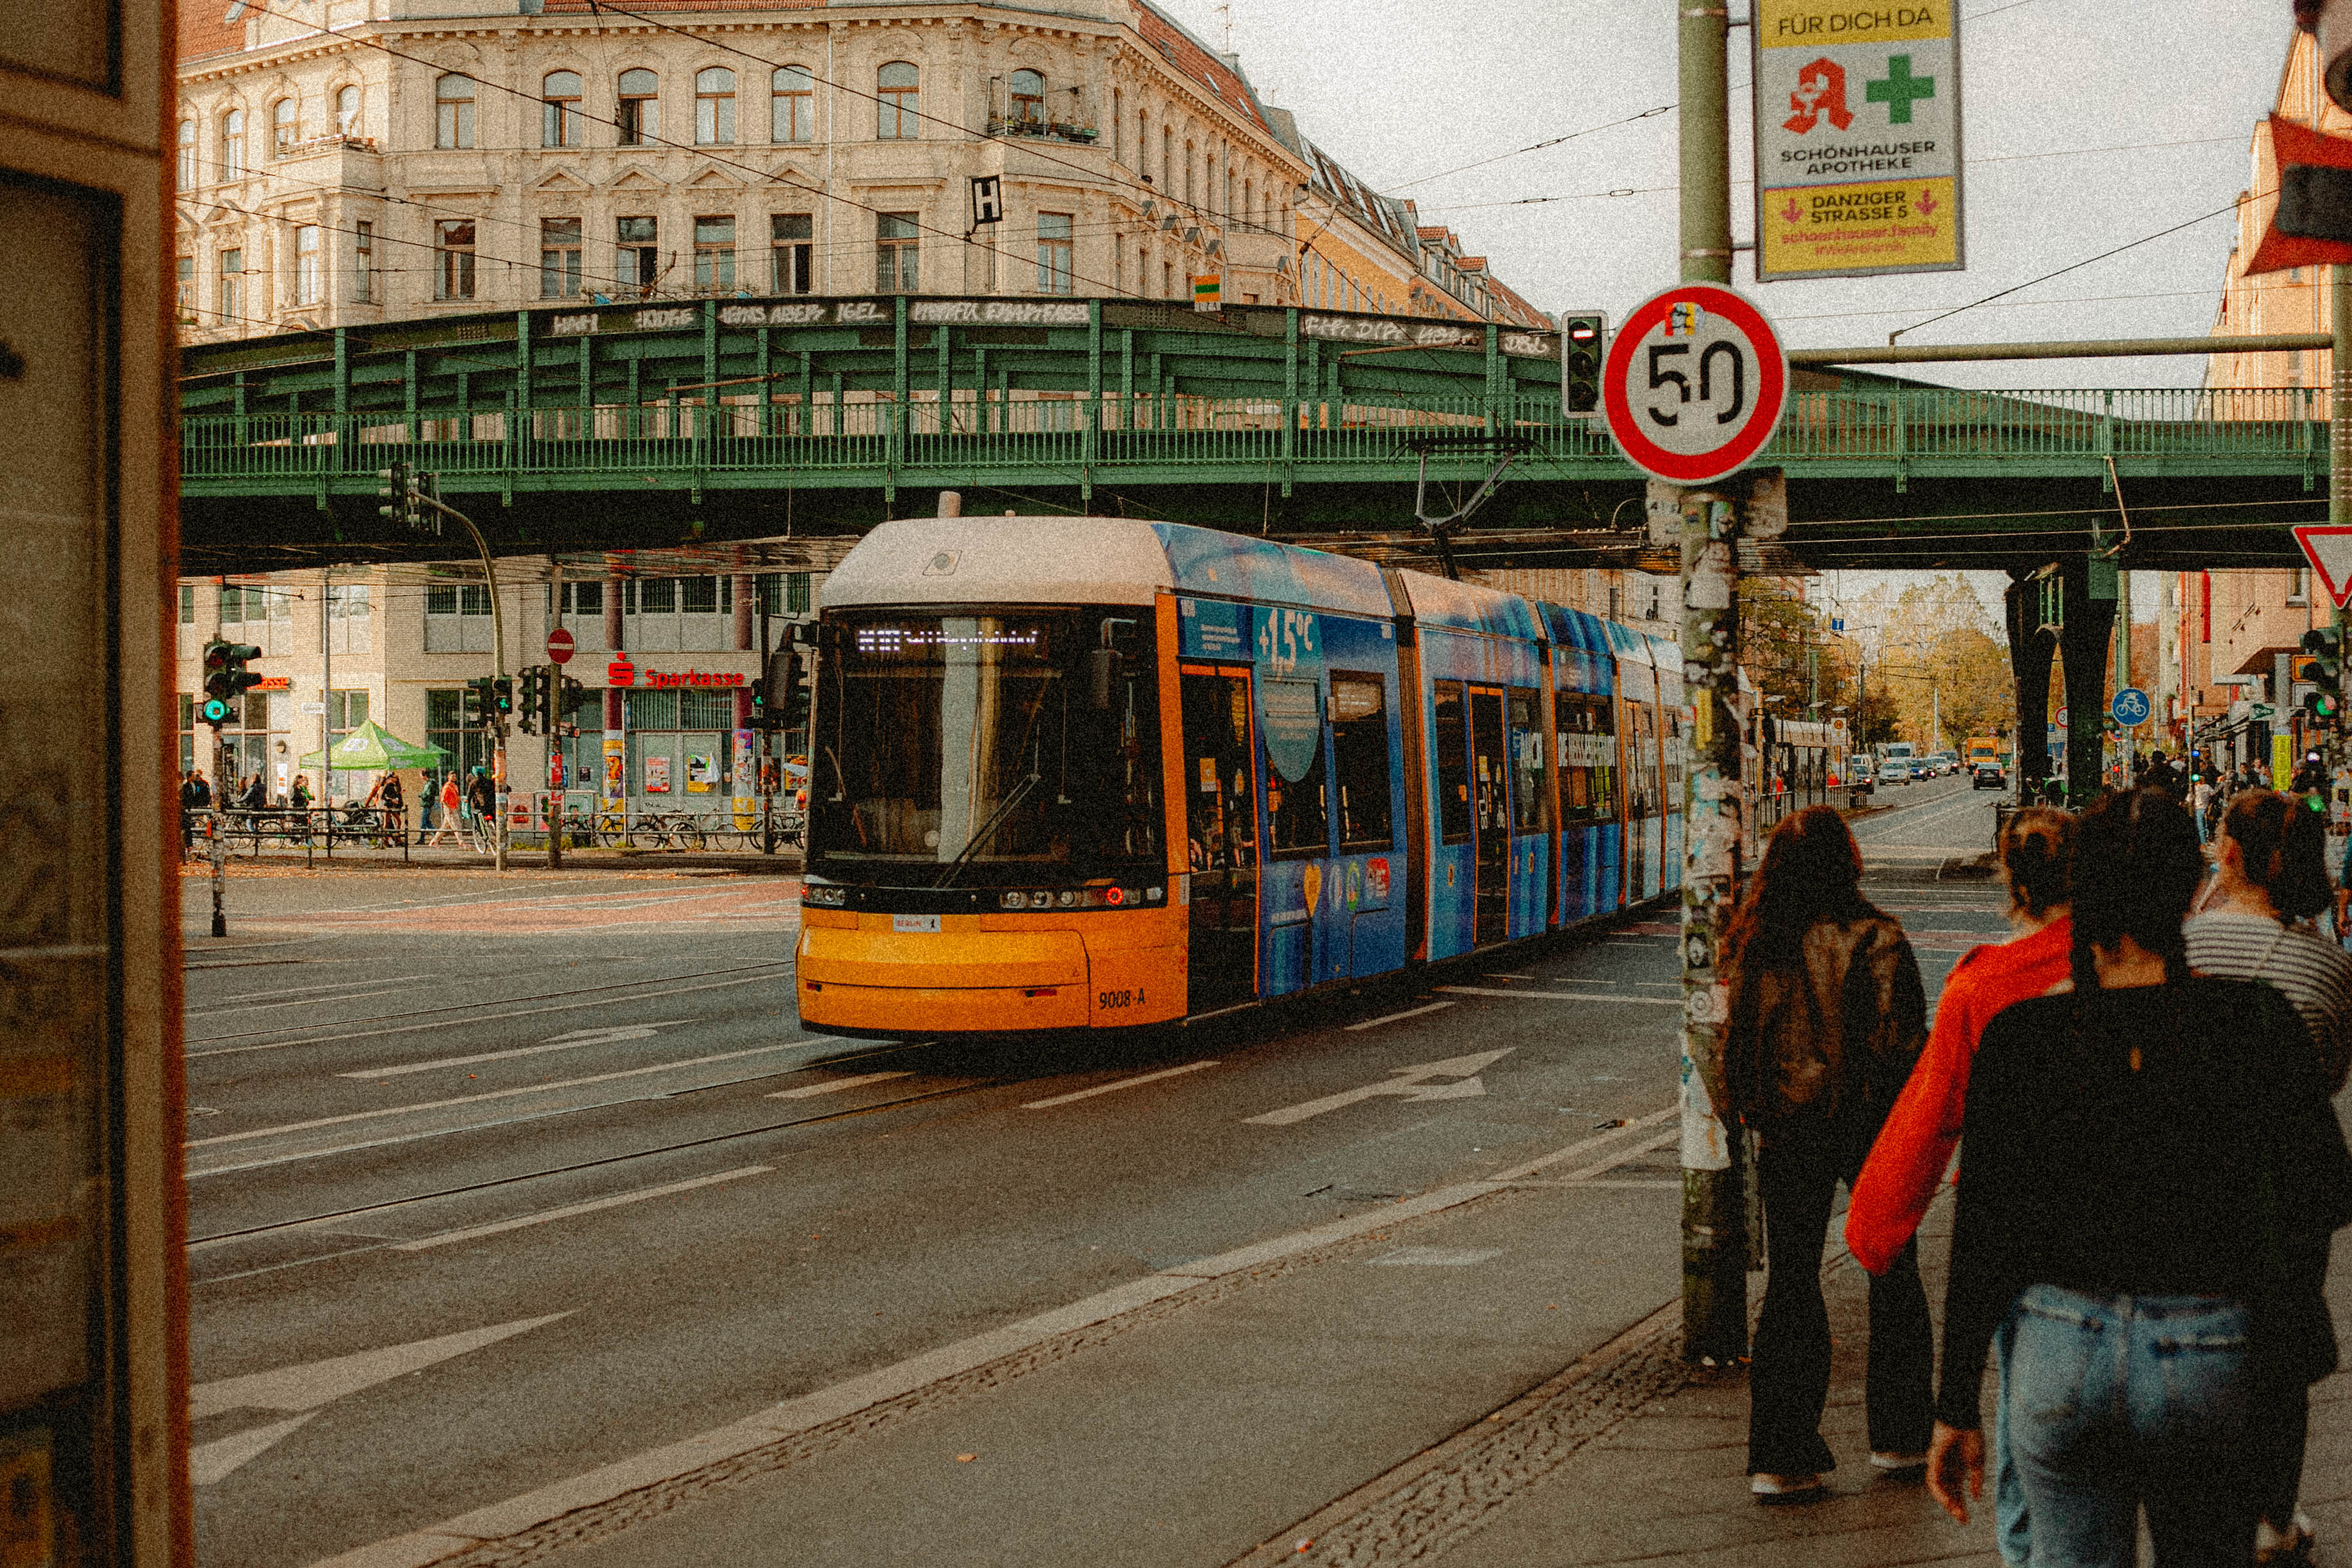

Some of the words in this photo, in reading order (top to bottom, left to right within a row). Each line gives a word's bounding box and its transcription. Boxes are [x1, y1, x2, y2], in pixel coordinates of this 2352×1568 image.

[1779, 13, 1822, 35] FÜR
[1830, 11, 1890, 32] DICH
[1898, 8, 1933, 26] DA
[1781, 141, 1935, 162] SCHÖNHAUSER
[1807, 157, 1912, 175] APOTHEKE
[974, 180, 999, 220] H
[1812, 191, 1905, 209] DANZIGER
[1812, 207, 1892, 223] STRASSE
[1898, 205, 1907, 219] 5
[1649, 341, 1743, 426] 50
[645, 668, 744, 690] Sparkasse
